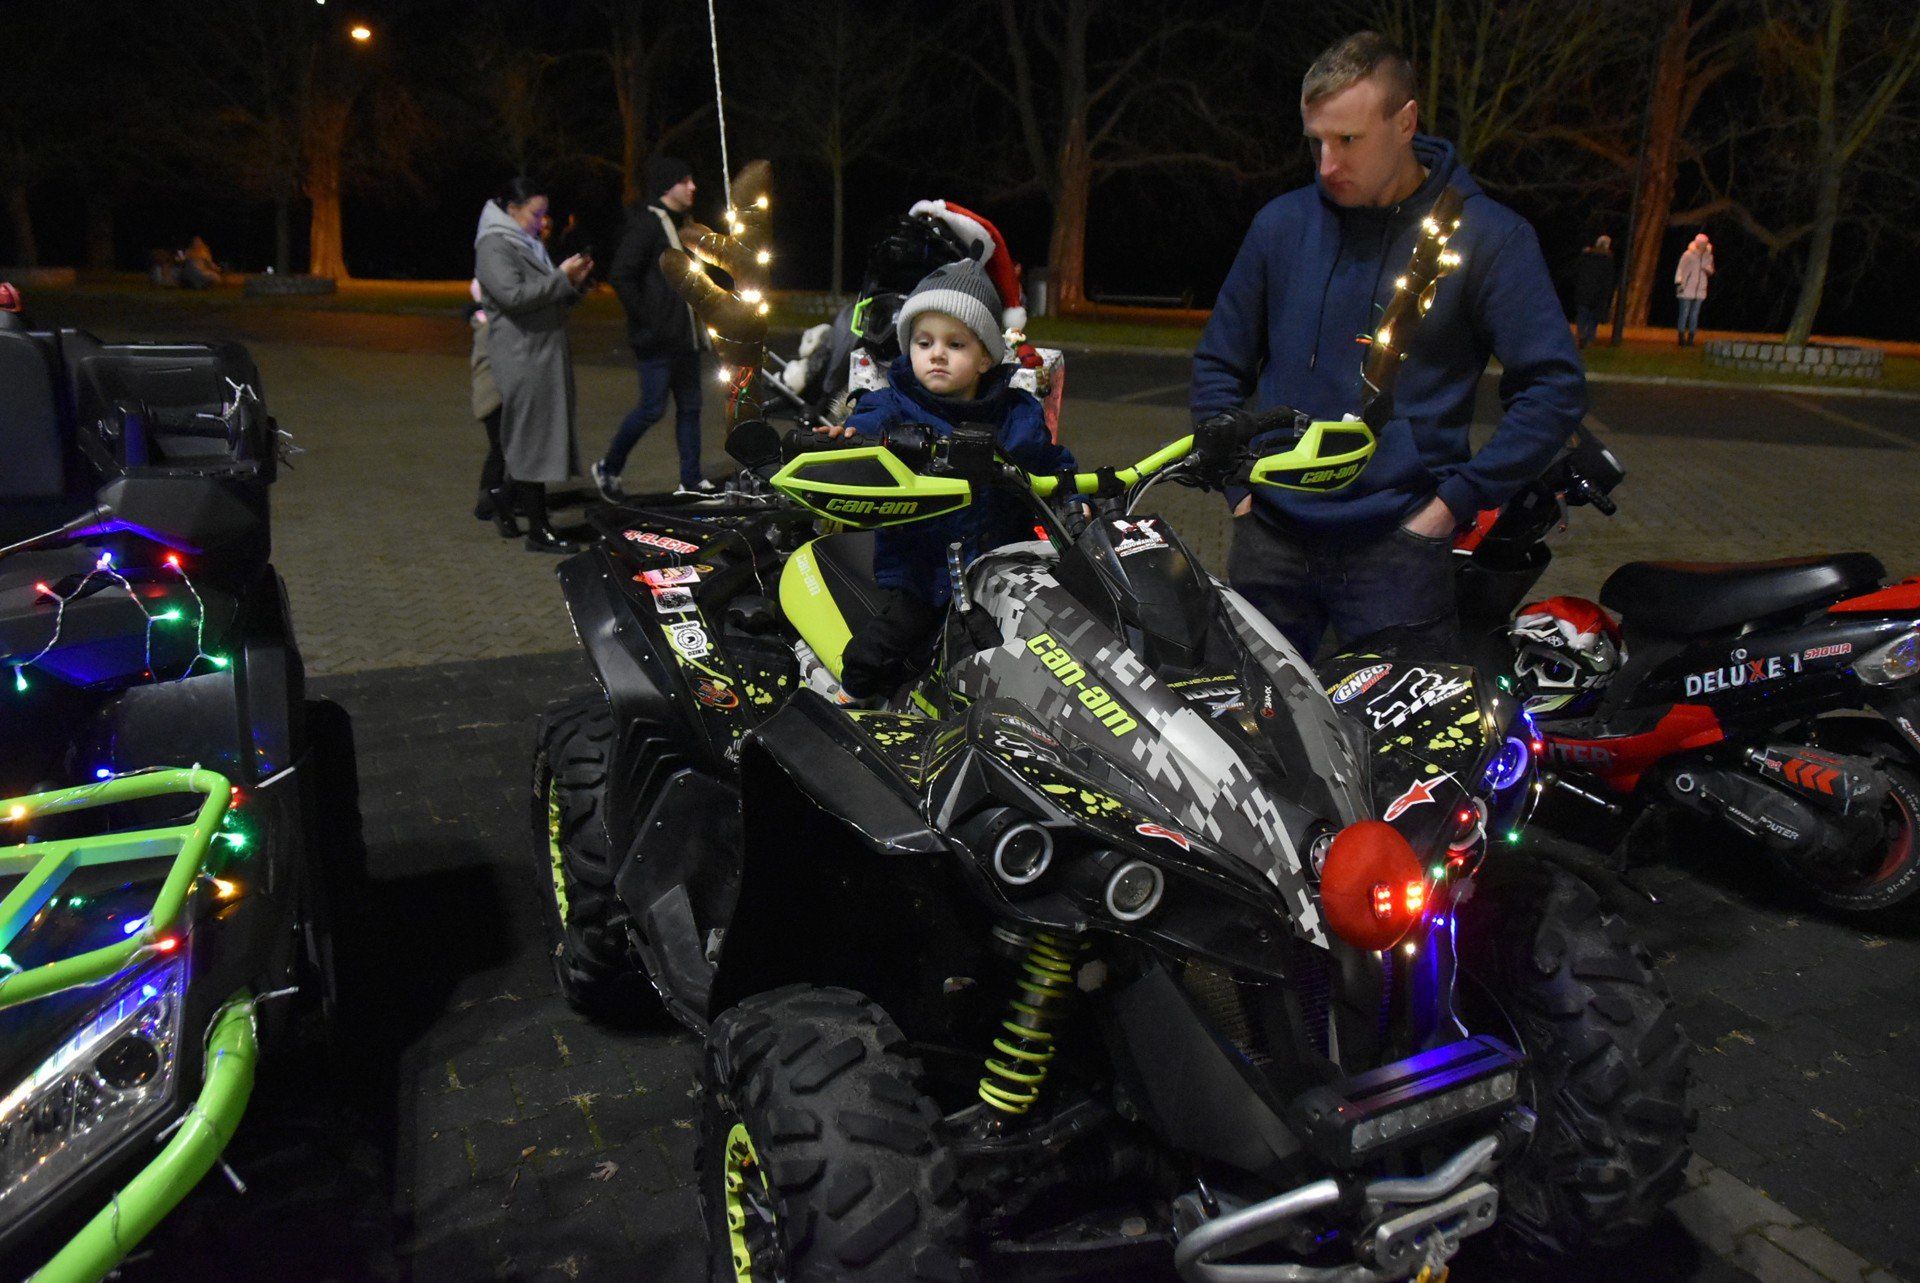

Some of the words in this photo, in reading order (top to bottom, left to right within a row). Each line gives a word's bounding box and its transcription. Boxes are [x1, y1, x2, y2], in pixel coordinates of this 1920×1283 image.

[1300, 463, 1359, 484] can-am
[825, 498, 919, 515] can-am
[1803, 643, 1852, 660] SHOWA
[1026, 633, 1138, 737] can-am
[1166, 675, 1237, 689] RENEGADE
[1338, 664, 1384, 701] GNCC
[1685, 656, 1781, 697] DELUXE
[1181, 686, 1242, 701] 1000
